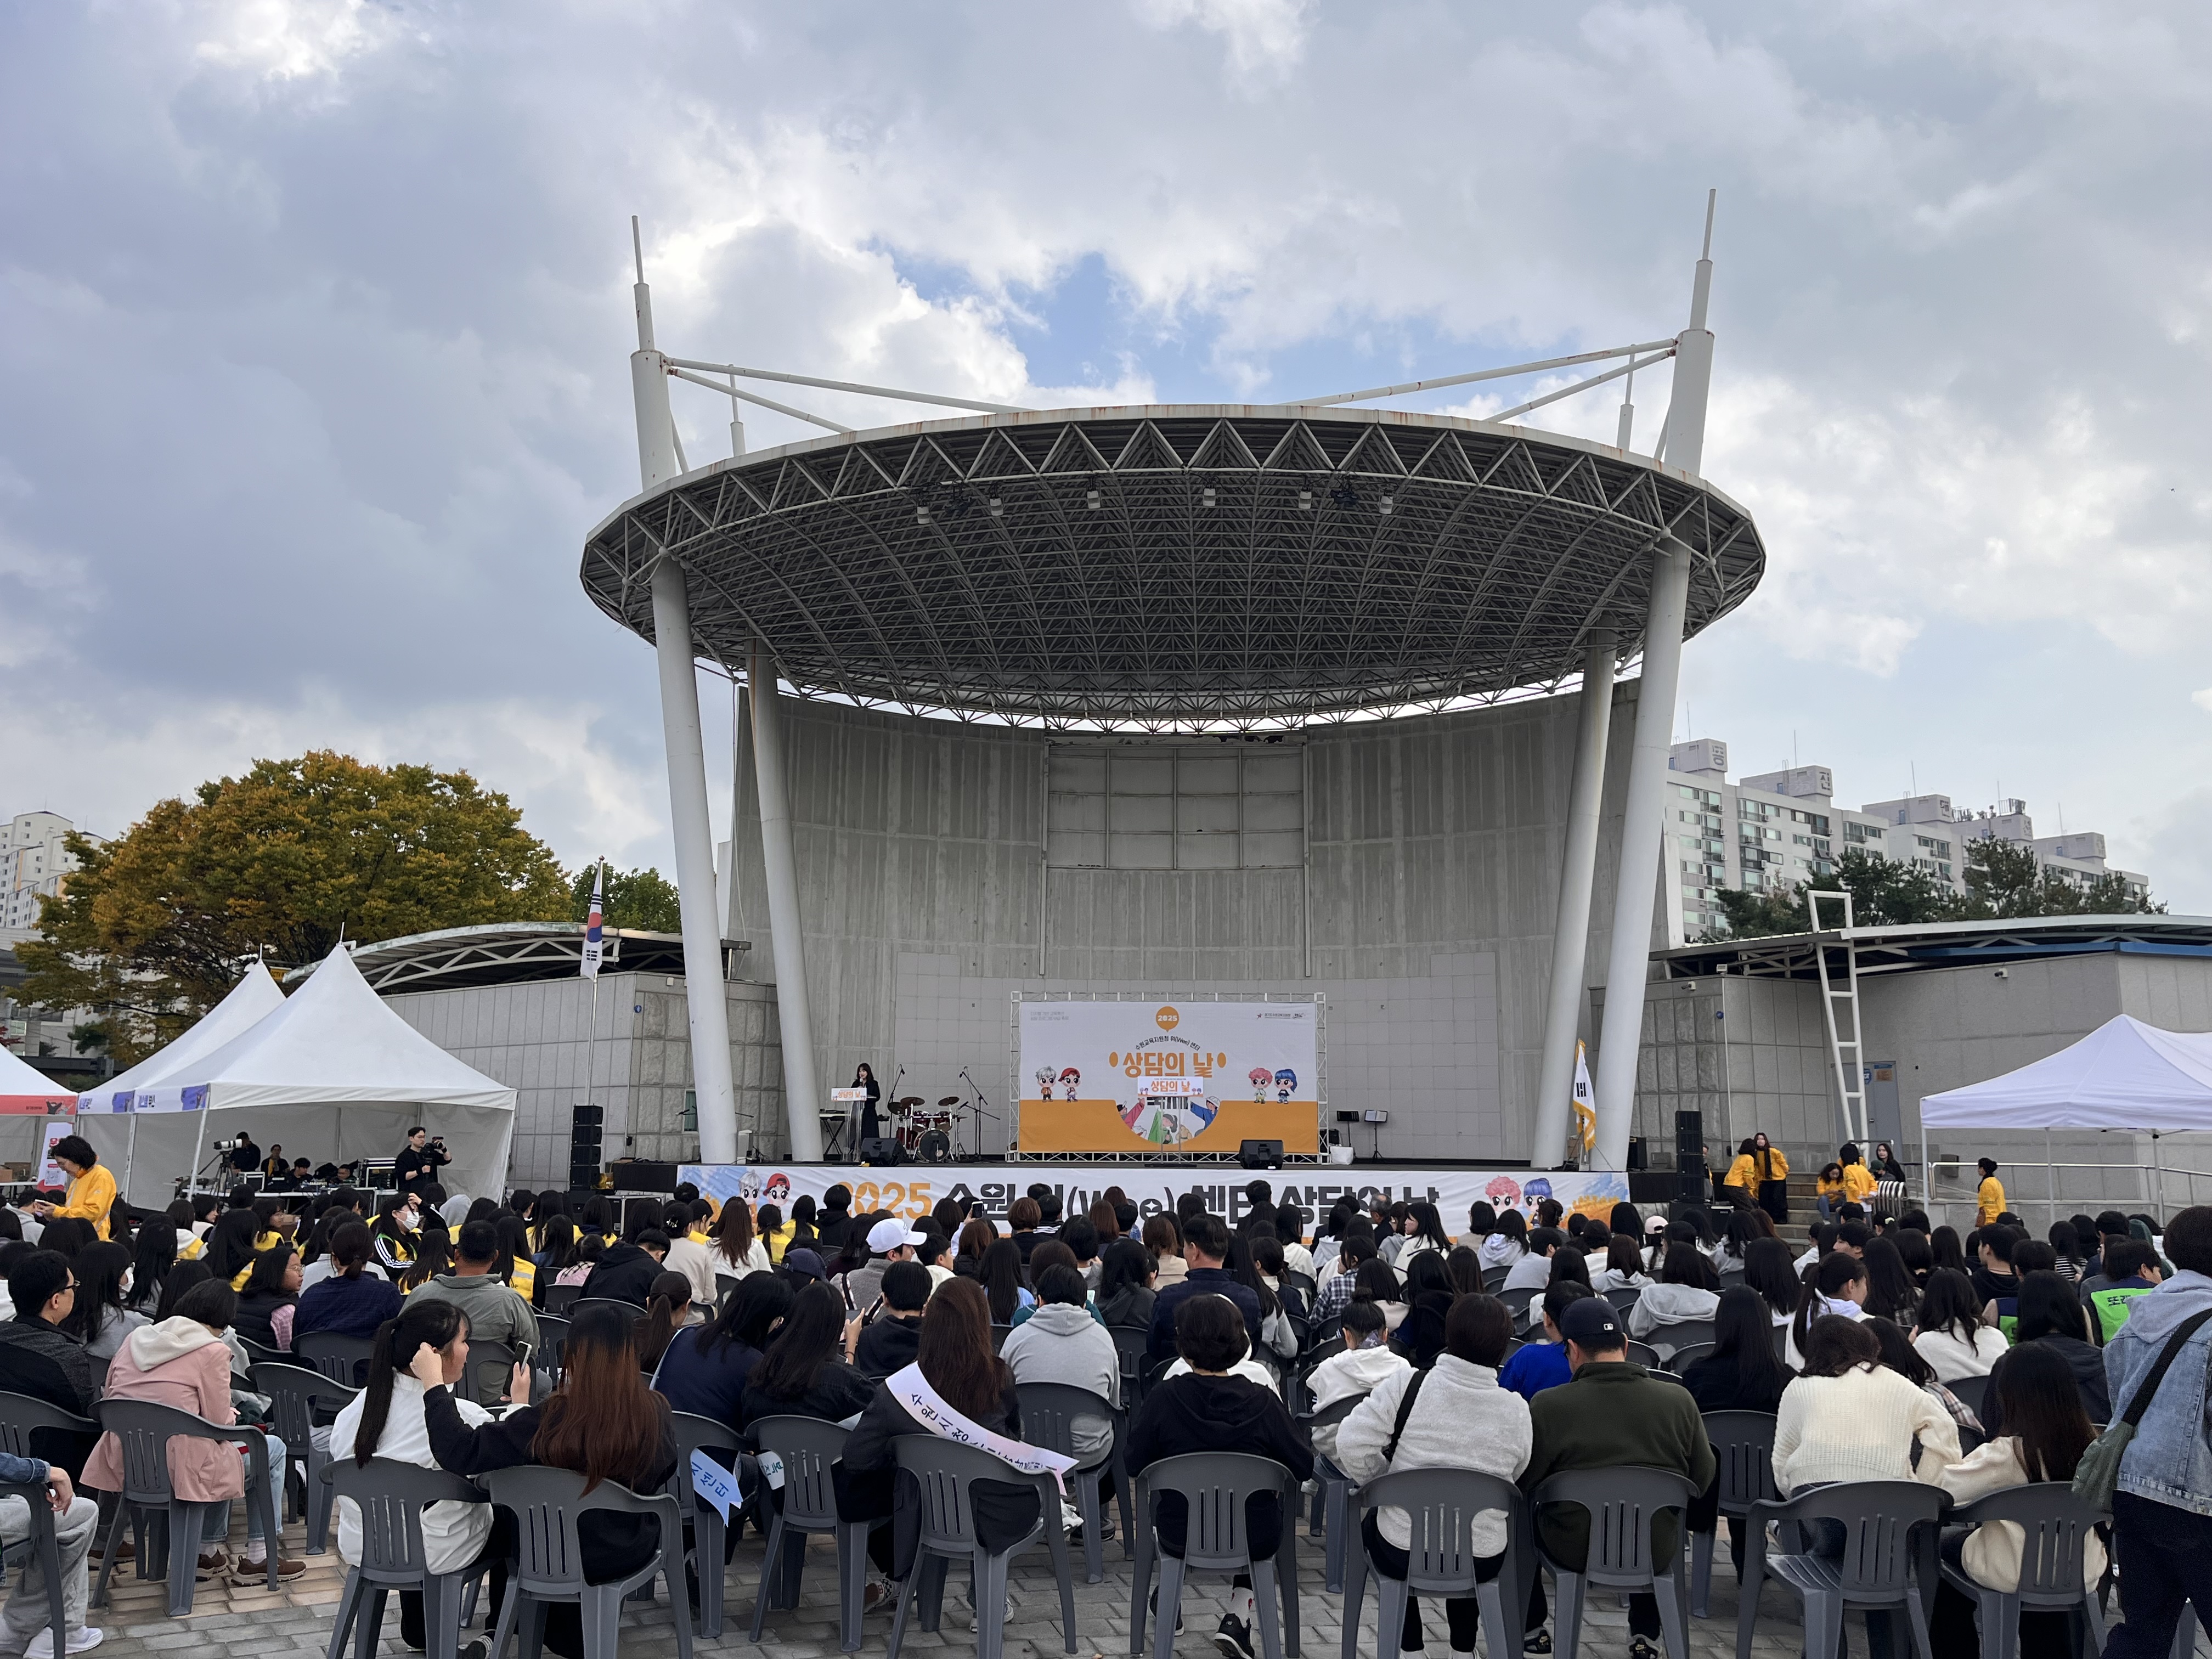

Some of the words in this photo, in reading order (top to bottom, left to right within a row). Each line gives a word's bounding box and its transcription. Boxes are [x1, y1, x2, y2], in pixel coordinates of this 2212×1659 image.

[1157, 1014, 1178, 1023] 2025
[1135, 1035, 1169, 1051] 수원교육지원청
[1189, 1042, 1201, 1052] 센터
[1122, 1052, 1185, 1079] 상담의
[1192, 1052, 1214, 1079] 날
[1150, 1080, 1178, 1092] 상담의
[1181, 1080, 1190, 1092] 날
